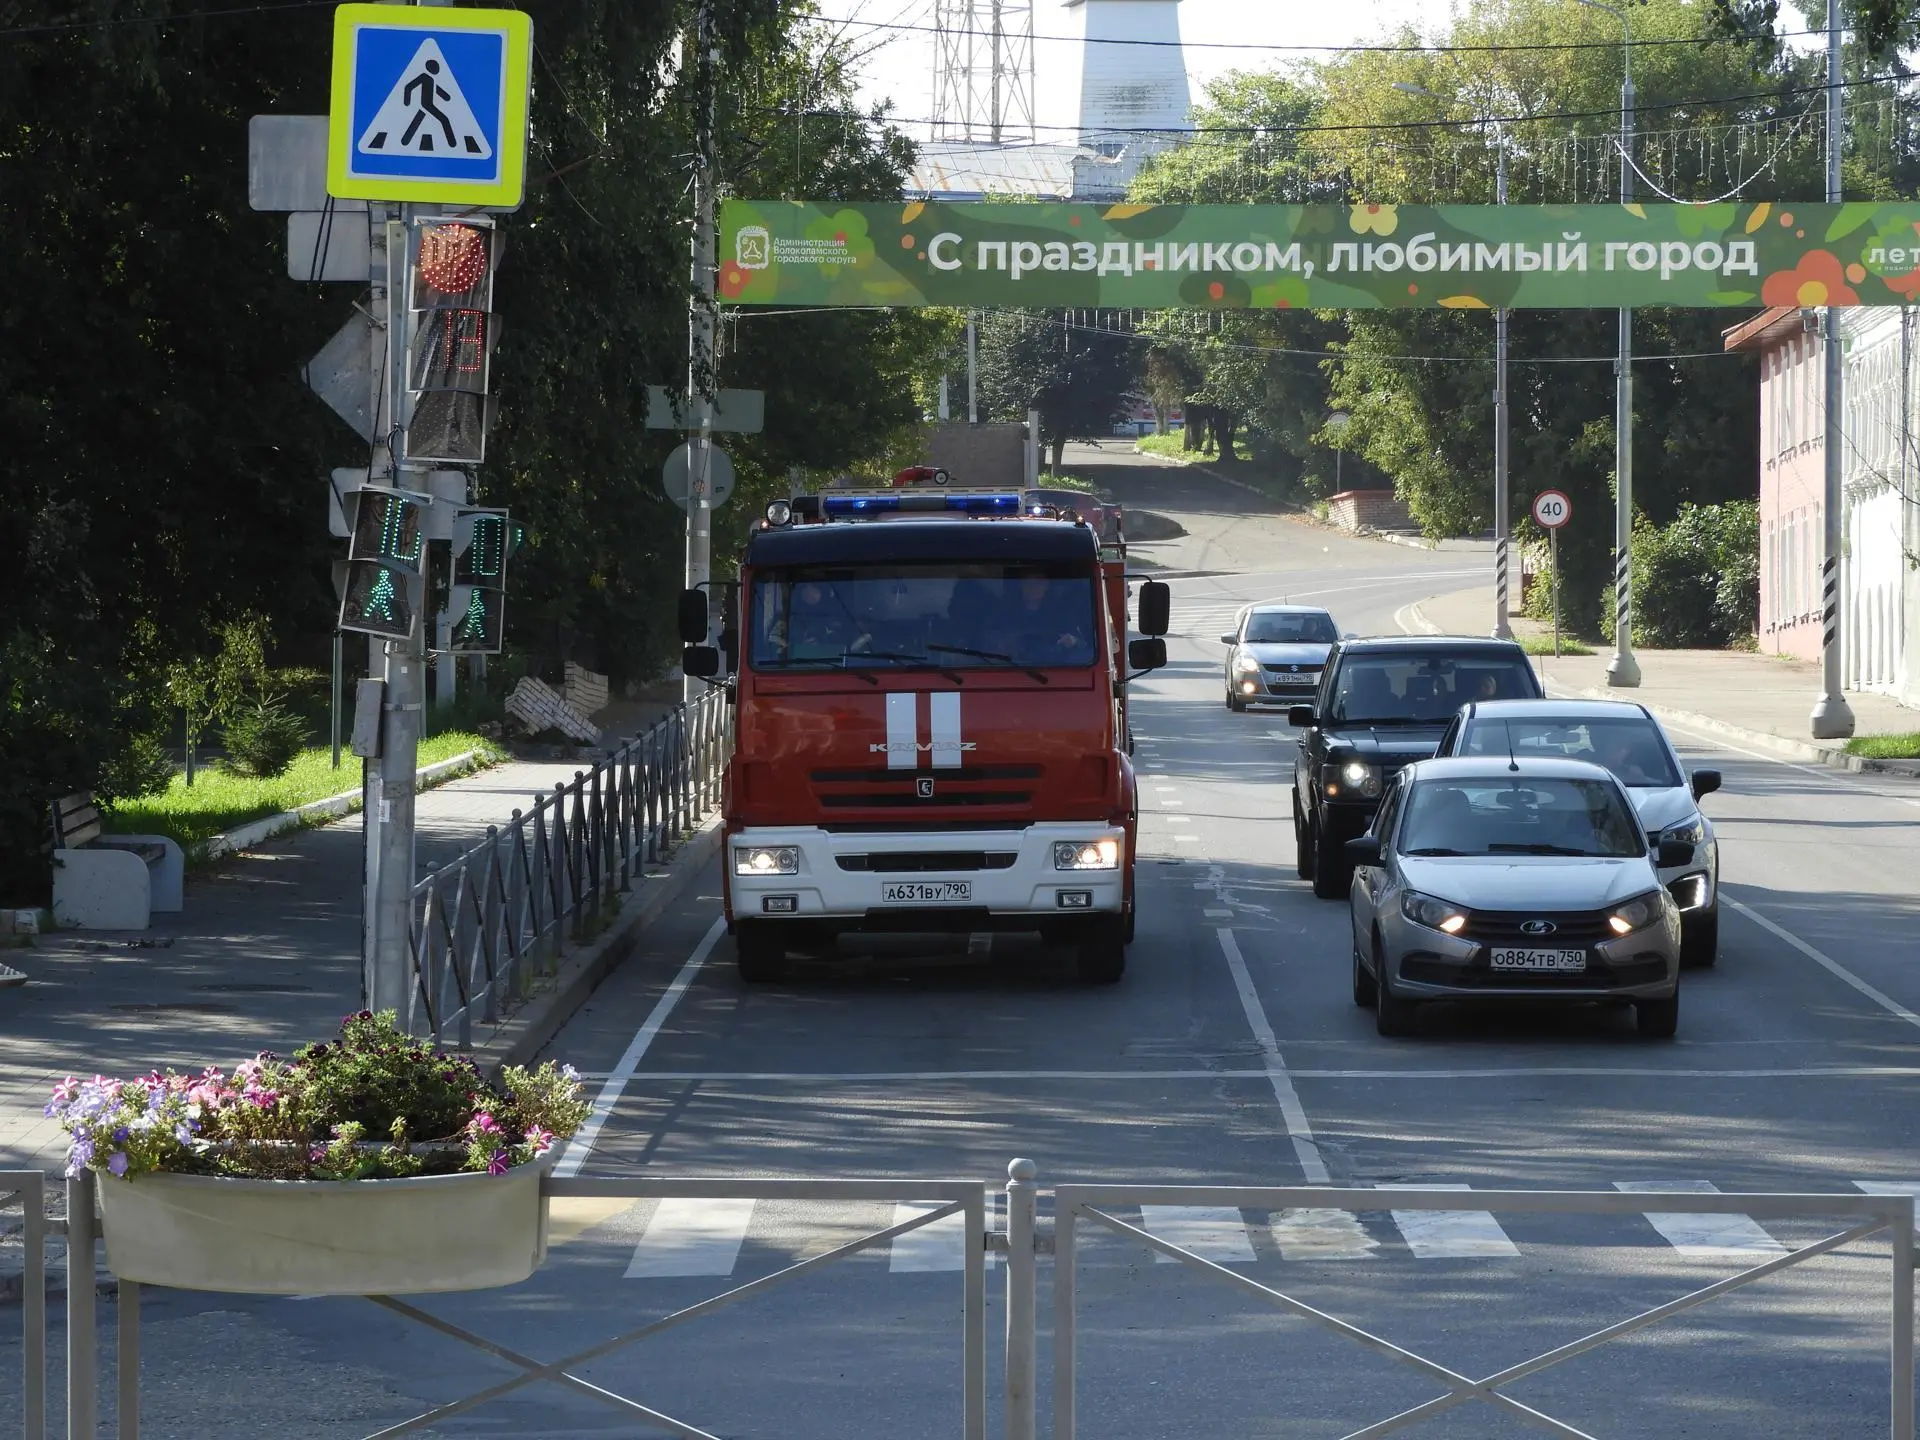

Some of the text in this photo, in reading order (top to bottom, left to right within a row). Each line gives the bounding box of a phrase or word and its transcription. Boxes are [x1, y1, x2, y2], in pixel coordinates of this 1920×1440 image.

[774, 238, 845, 248] Администрация
[774, 247, 848, 256] Волоколамского
[927, 231, 1758, 281] С праздником, любимый город
[774, 256, 857, 265] городского округа
[1541, 502, 1562, 517] 40
[945, 883, 967, 895] 790
[1559, 951, 1582, 963] 750
